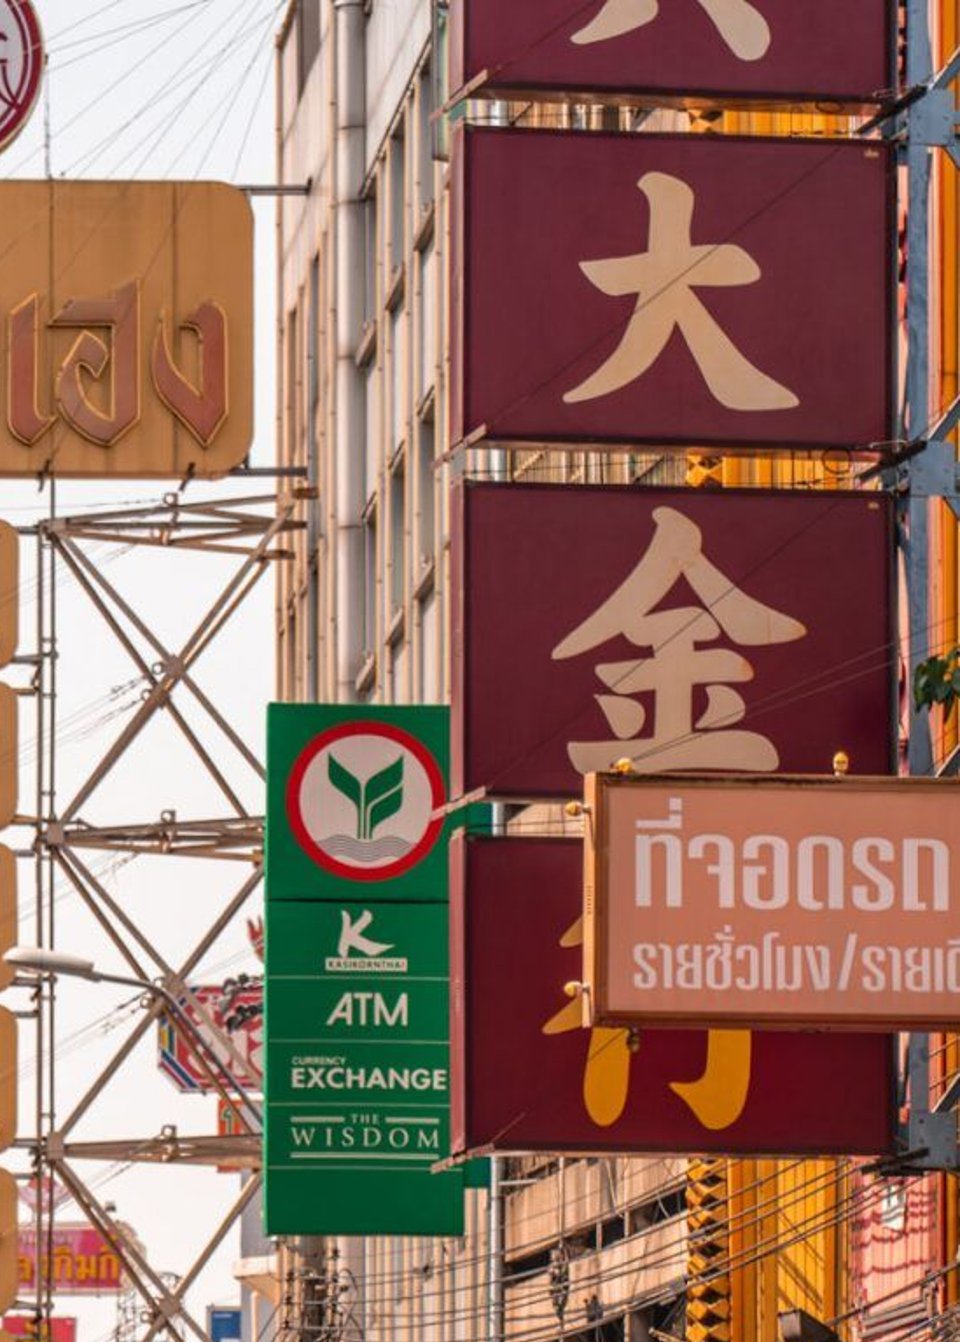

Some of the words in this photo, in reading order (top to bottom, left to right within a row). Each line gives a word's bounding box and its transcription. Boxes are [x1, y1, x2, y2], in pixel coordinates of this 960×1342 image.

[634, 796, 950, 911] ที่จอดรถ
[327, 993, 409, 1026] ATM
[292, 1057, 347, 1066] CURRENCY
[290, 1067, 447, 1091] EXCHANGE
[350, 1113, 380, 1124] THE
[291, 1127, 439, 1148] WISDOM
